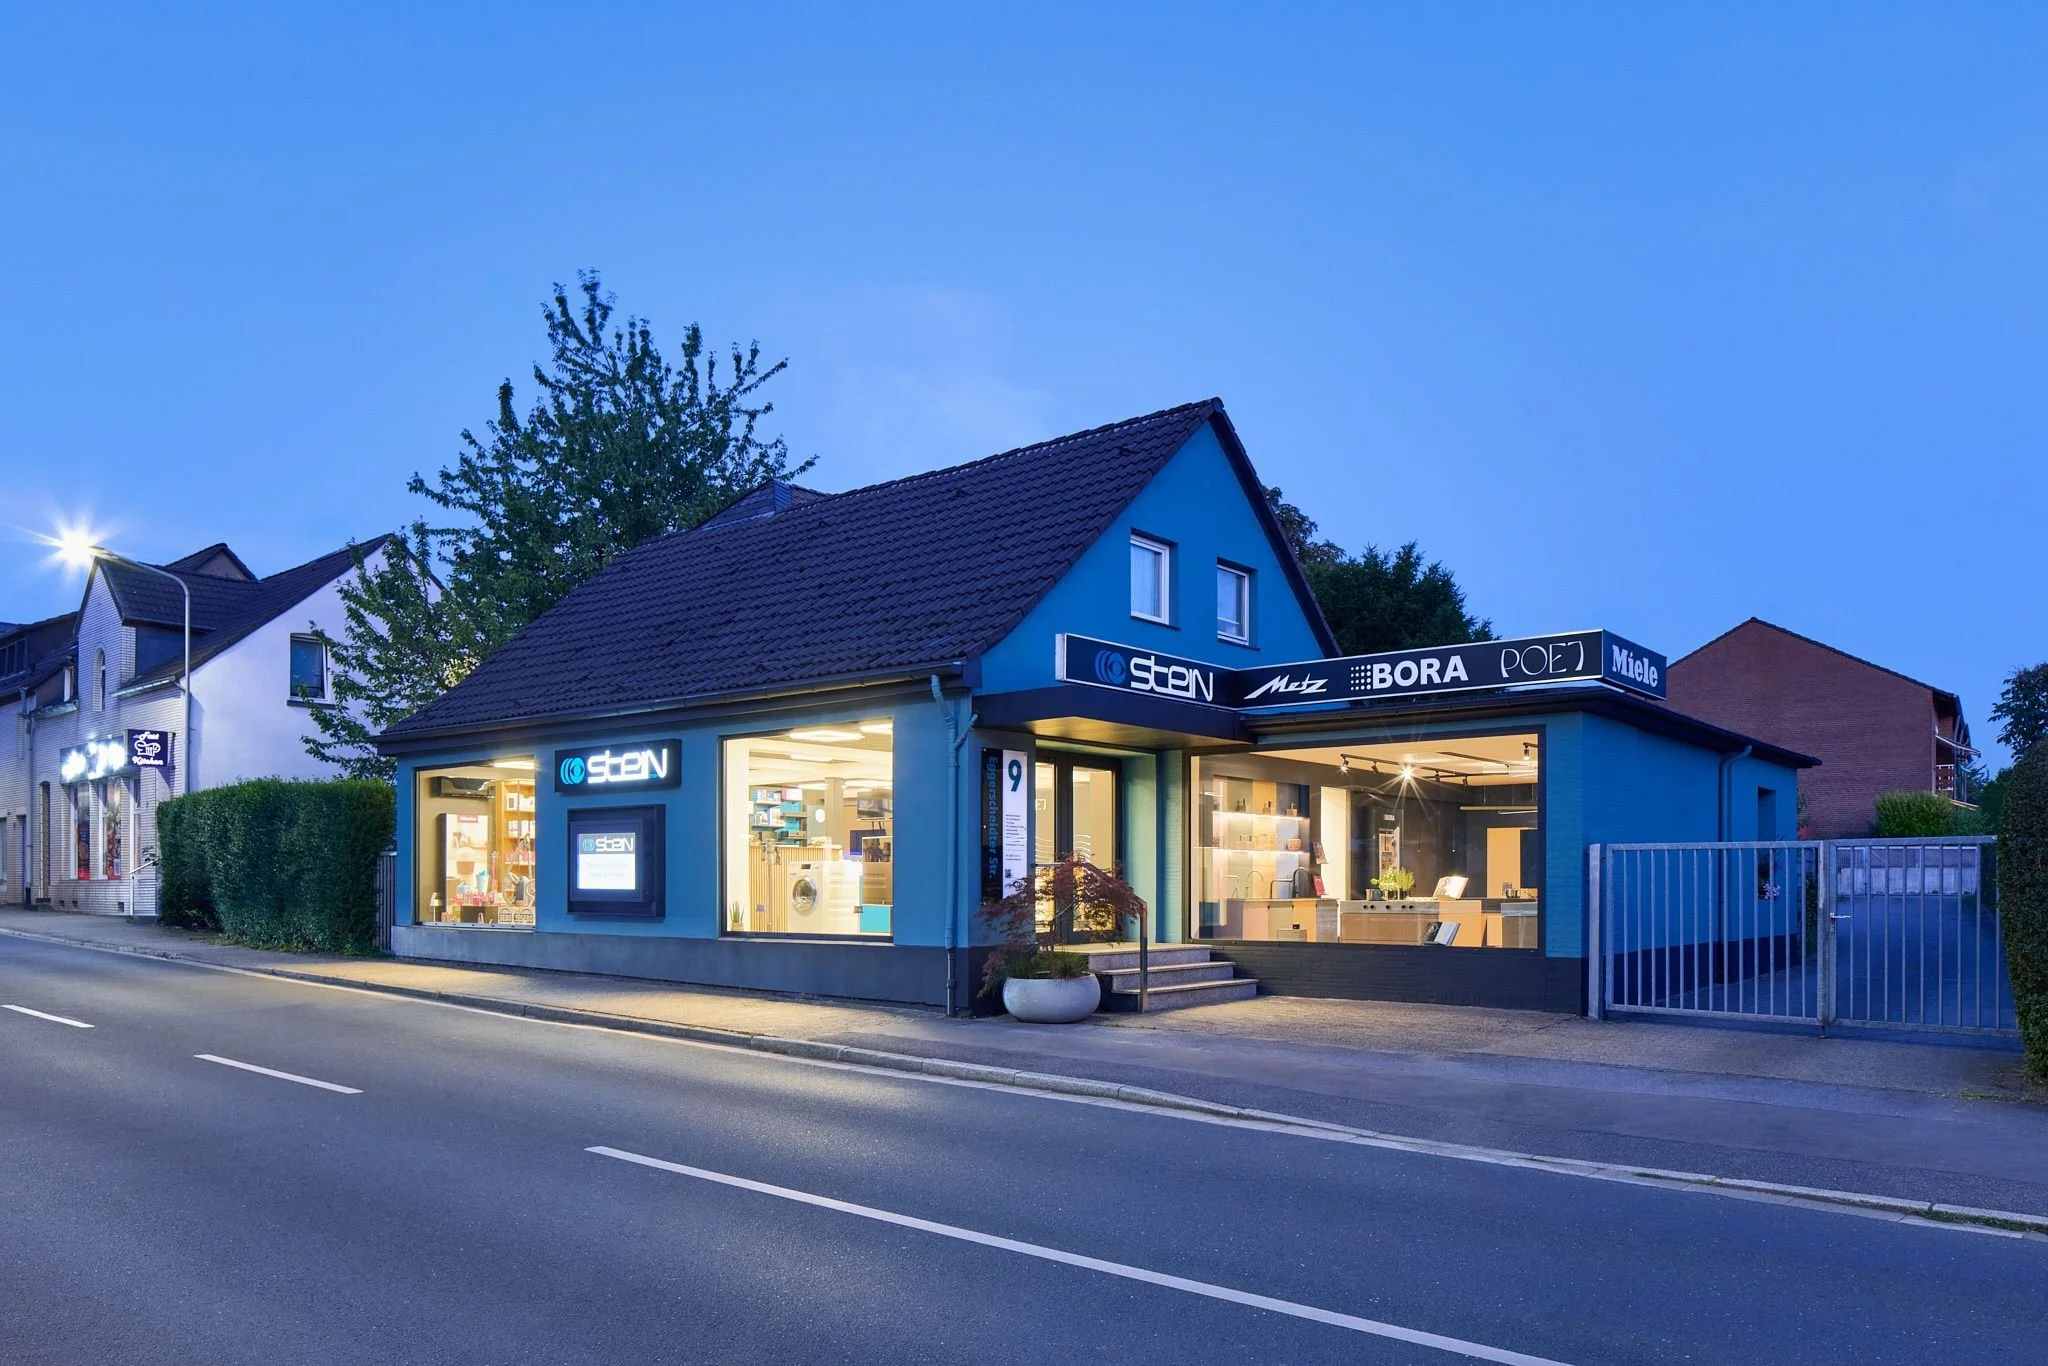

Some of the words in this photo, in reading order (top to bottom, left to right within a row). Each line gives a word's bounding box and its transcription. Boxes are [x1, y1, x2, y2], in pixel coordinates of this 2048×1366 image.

[1372, 655, 1469, 689] BORA
[1612, 644, 1658, 688] Miele
[1243, 672, 1328, 700] Metz
[1007, 759, 1022, 792] 9
[986, 756, 998, 853] Eggerscheidter
[989, 856, 999, 879] Str.
